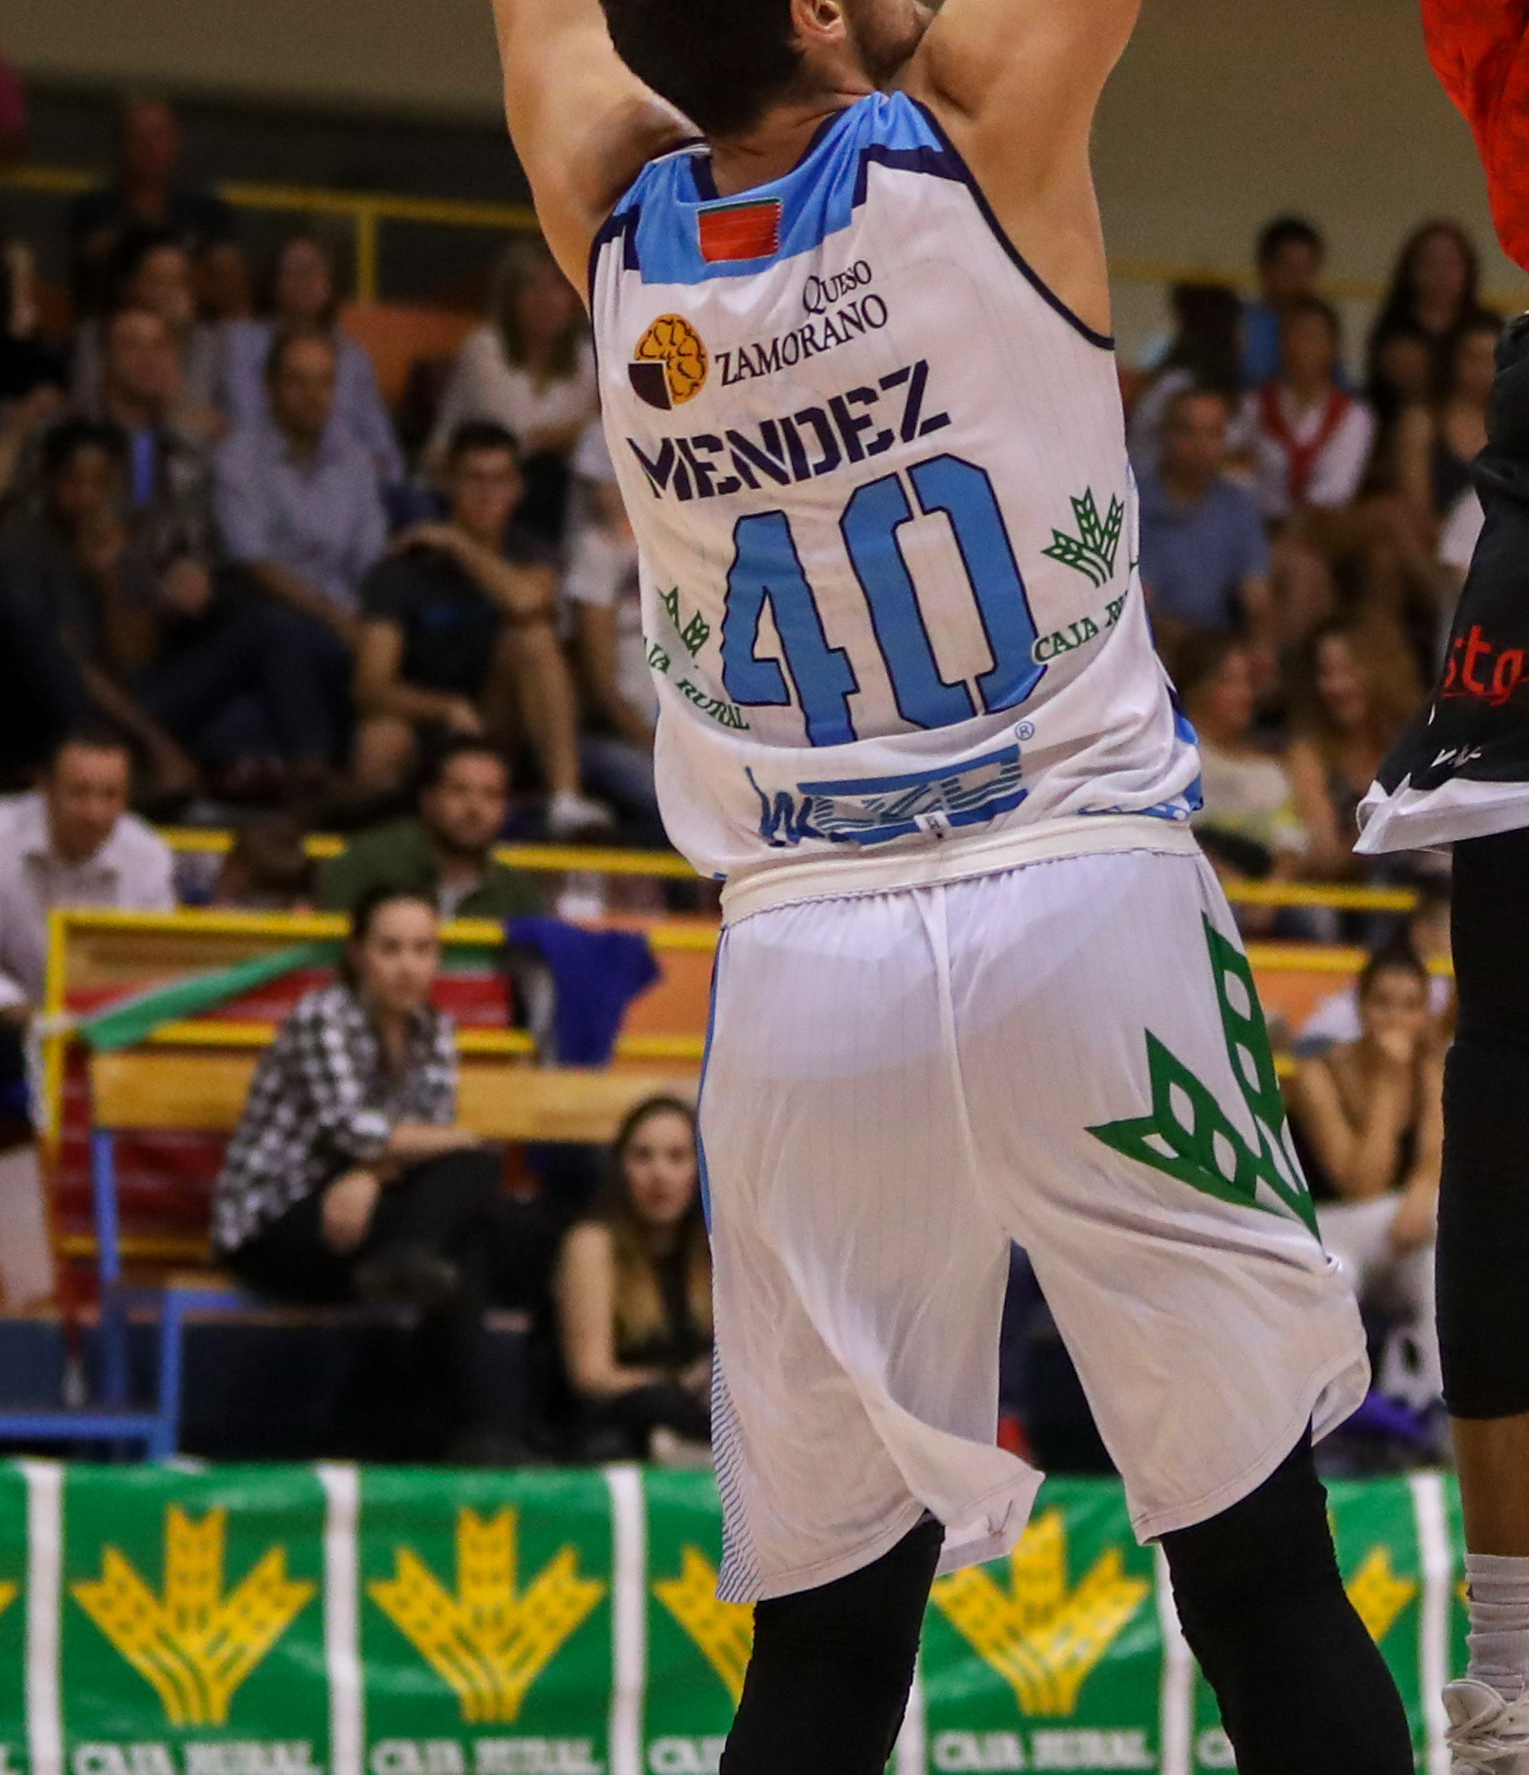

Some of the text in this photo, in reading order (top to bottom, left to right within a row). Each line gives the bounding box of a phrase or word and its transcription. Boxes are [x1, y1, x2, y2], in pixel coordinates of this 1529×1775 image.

[714, 293, 888, 387] ZAMORANO
[625, 358, 952, 502] MENDEZ
[719, 455, 1048, 748] 40
[1033, 616, 1099, 663] CAJA
[675, 678, 751, 730] RURAL
